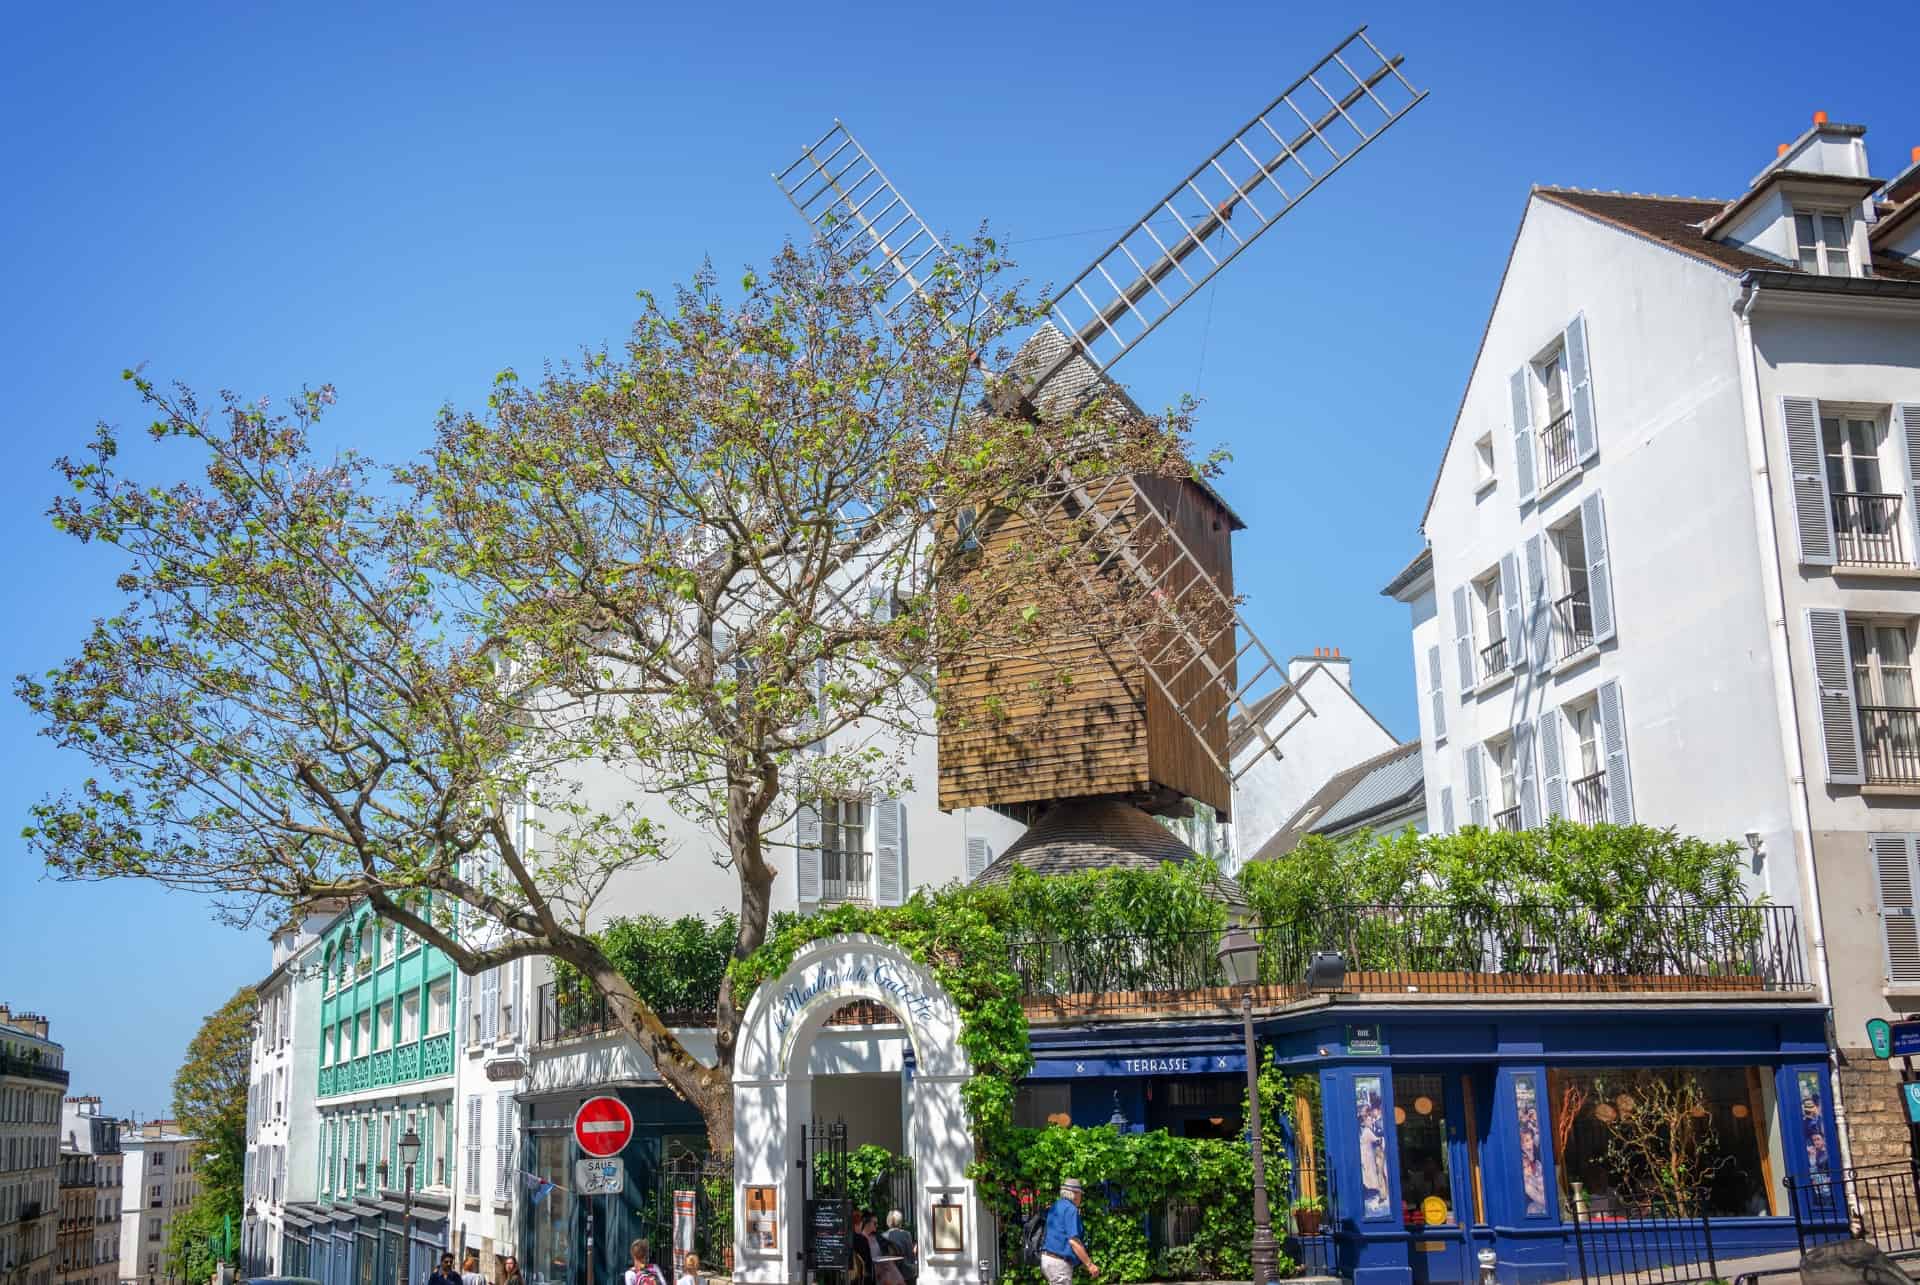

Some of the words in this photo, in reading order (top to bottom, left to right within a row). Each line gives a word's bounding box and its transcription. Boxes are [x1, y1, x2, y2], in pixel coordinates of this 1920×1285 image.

[785, 966, 838, 1017] Moulin
[874, 964, 931, 1021] Galette
[1126, 1058, 1188, 1072] TERRASSE
[588, 1160, 616, 1170] SAUF
